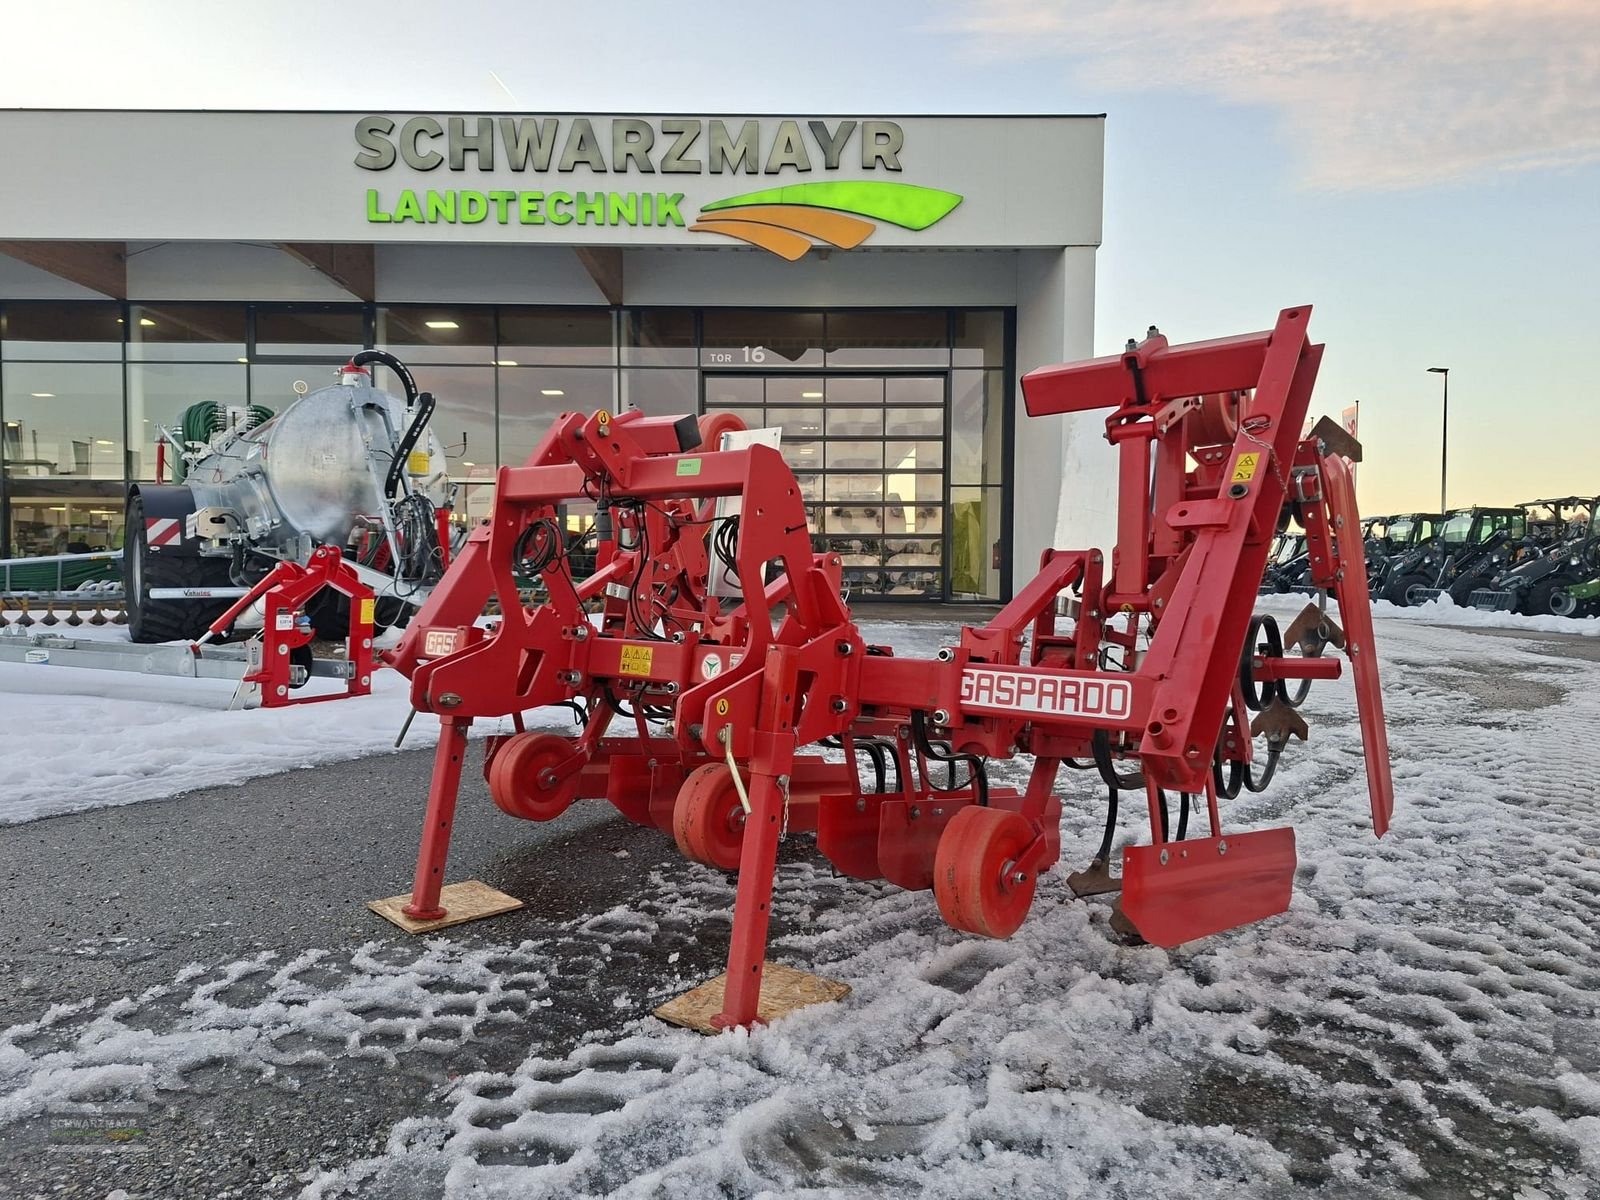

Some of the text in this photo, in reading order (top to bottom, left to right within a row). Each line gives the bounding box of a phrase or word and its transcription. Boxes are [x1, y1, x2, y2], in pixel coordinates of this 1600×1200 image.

[354, 115, 904, 175] SCHWARZMAYR
[366, 189, 685, 226] LANDTECHNIK
[710, 345, 765, 363] TOR 16
[960, 672, 1128, 716] GASPARDO
